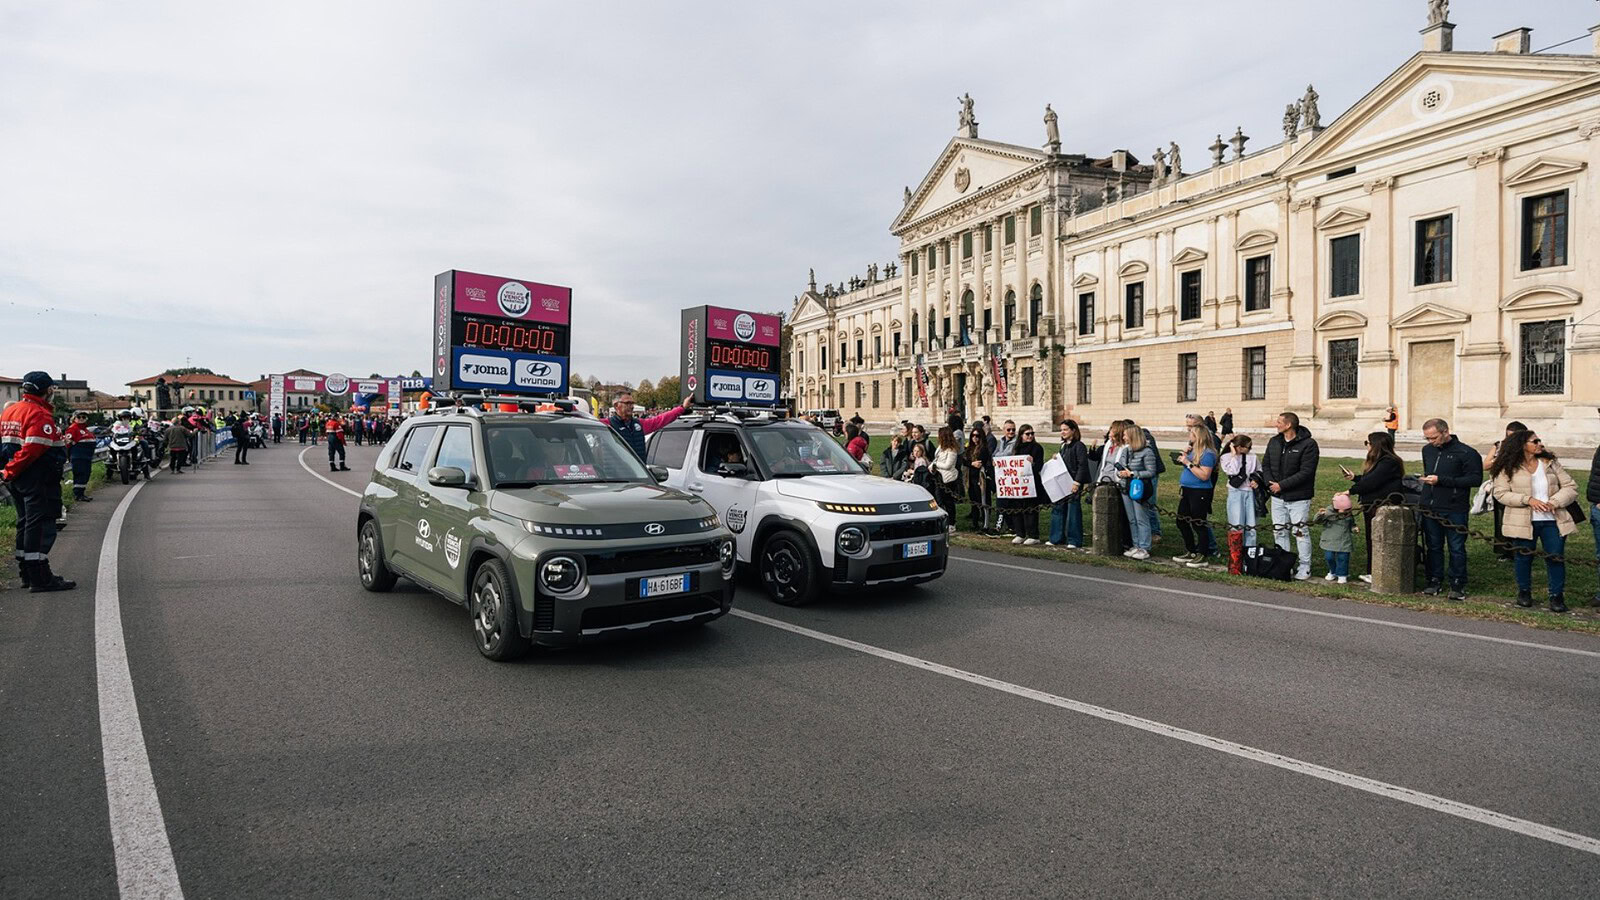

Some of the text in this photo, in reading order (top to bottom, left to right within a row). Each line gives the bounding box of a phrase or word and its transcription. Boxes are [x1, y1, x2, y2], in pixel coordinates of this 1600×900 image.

[466, 322, 554, 350] 00:00:00
[712, 346, 769, 367] 00:00:00
[521, 378, 556, 386] HYUNDAI
[997, 460, 1007, 468] DAI
[1000, 486, 1029, 496] SPRITZ
[415, 536, 433, 552] HYUNDAI
